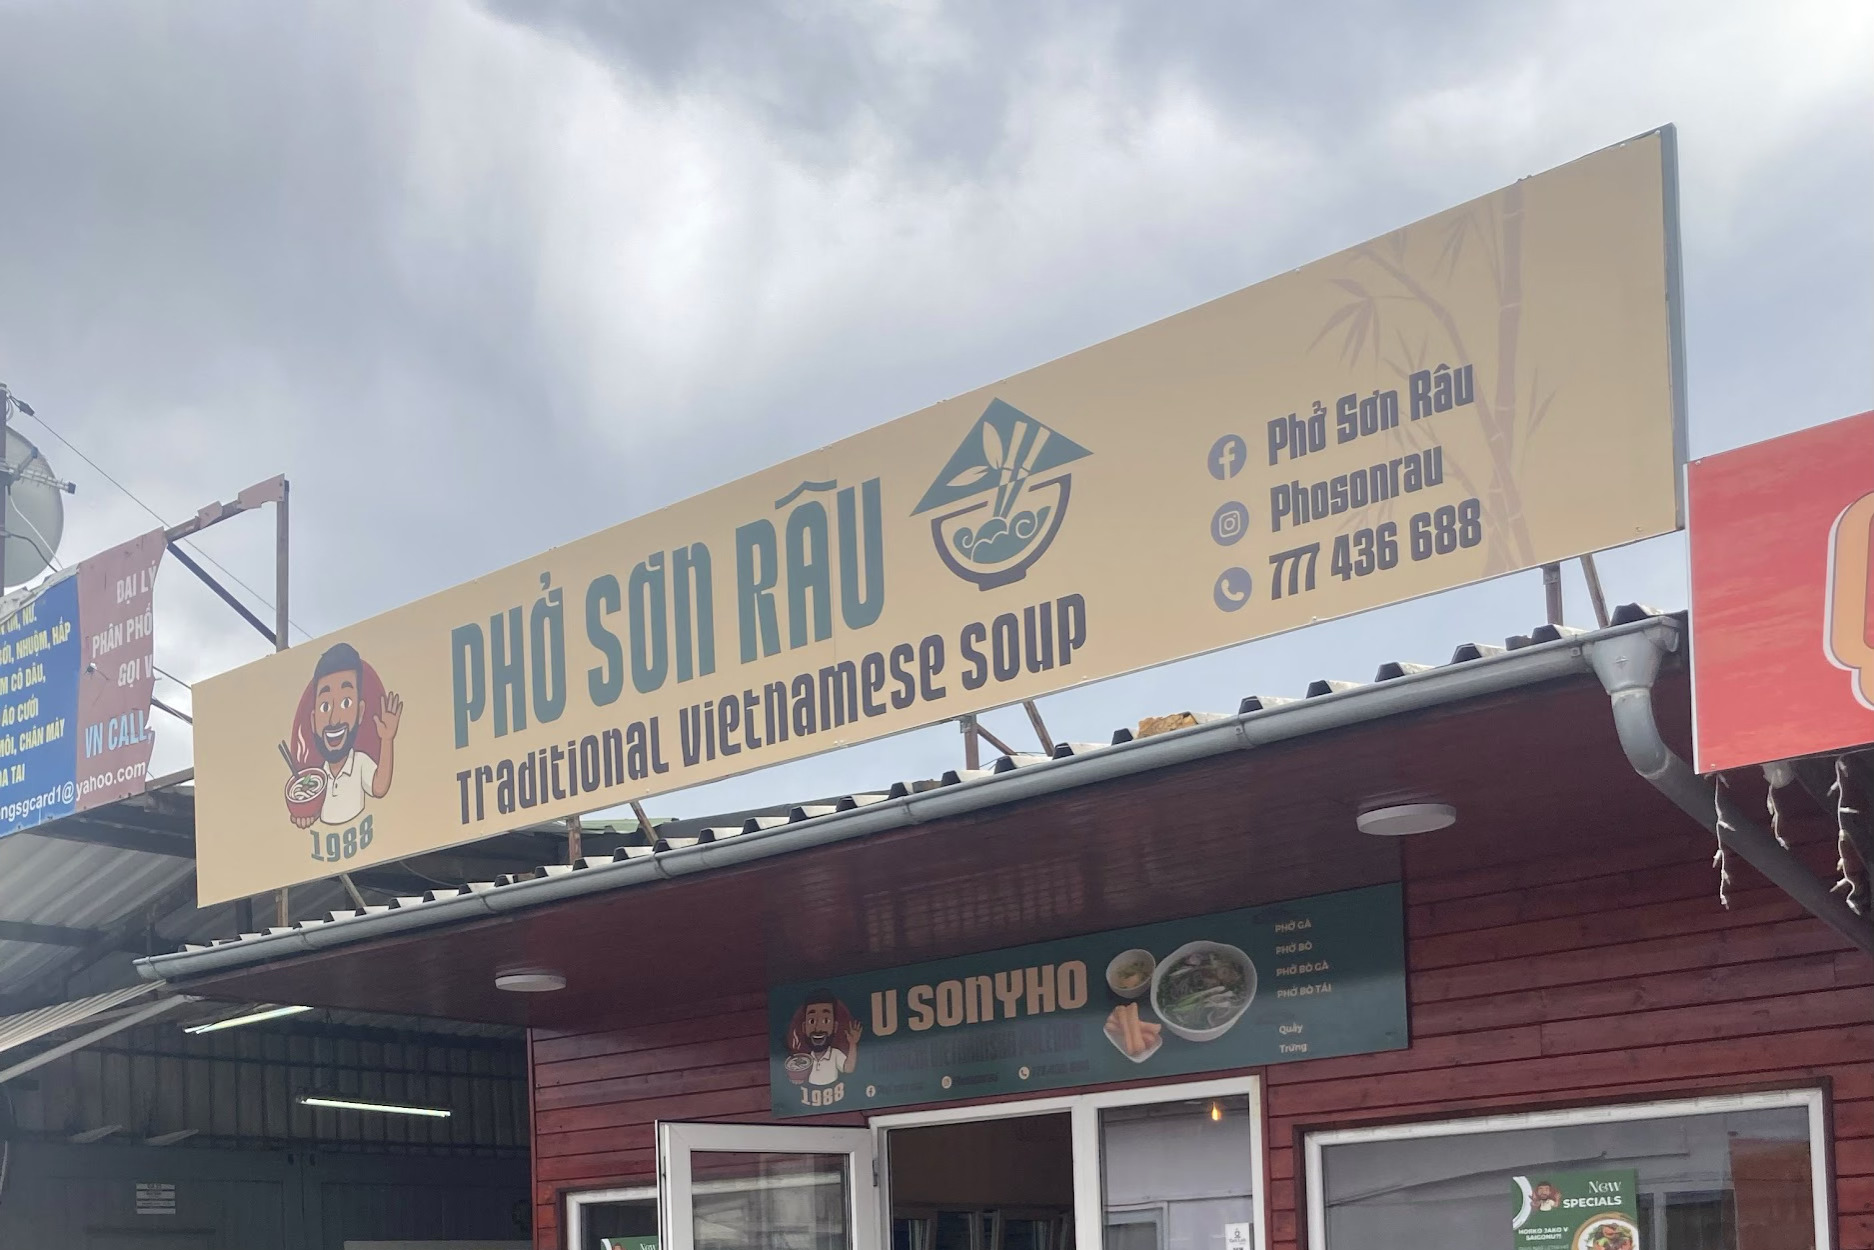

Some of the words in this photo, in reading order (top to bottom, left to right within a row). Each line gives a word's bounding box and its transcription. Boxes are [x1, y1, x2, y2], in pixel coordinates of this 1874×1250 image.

[1267, 400, 1327, 467] Phở
[1336, 388, 1399, 444] Sơn
[1408, 362, 1475, 423] Râu
[1270, 445, 1444, 533] Phosonrau
[1268, 542, 1321, 601] 777
[1330, 525, 1399, 582] 436
[1410, 498, 1482, 562] 688
[451, 572, 566, 749] PHỞ
[735, 476, 886, 665] RÂU
[85, 722, 104, 758] VN
[310, 814, 373, 863] 1988
[871, 989, 898, 1037] U
[907, 960, 1088, 1032] SONYHO
[800, 1082, 845, 1107] 1988
[1562, 1196, 1622, 1209] SPECIALS
